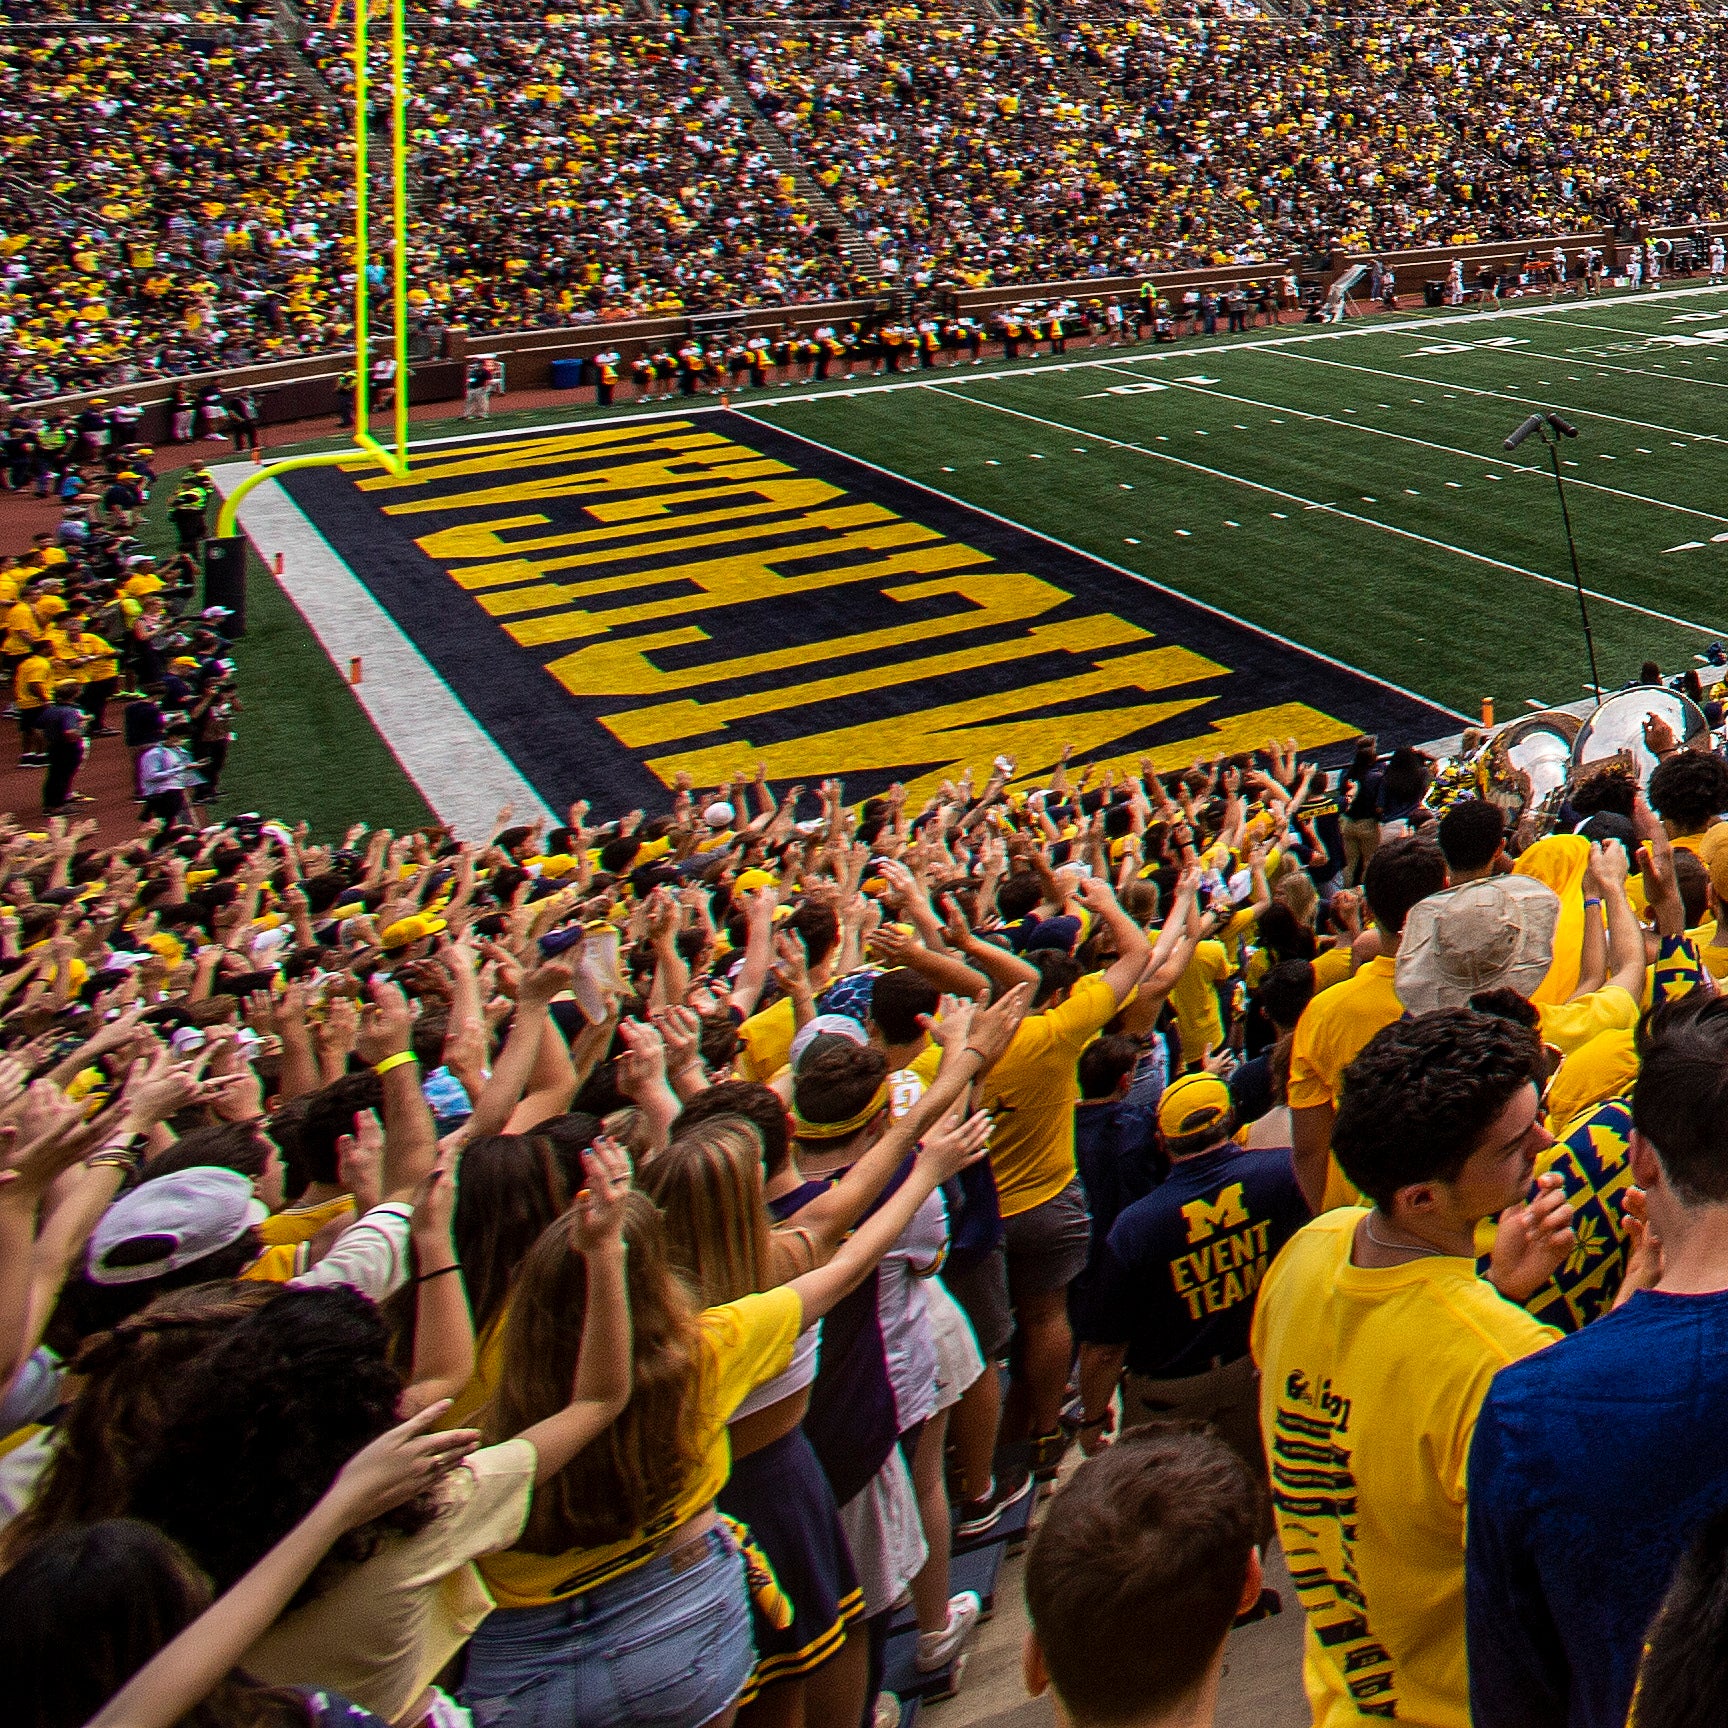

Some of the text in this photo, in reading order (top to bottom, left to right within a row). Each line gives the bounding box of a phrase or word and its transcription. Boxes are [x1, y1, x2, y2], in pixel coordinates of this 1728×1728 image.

[336, 419, 1365, 807] MICHIGAN
[1180, 1182, 1250, 1245] M
[1169, 1218, 1272, 1293] EVENT
[1181, 1254, 1270, 1320] TEAM
